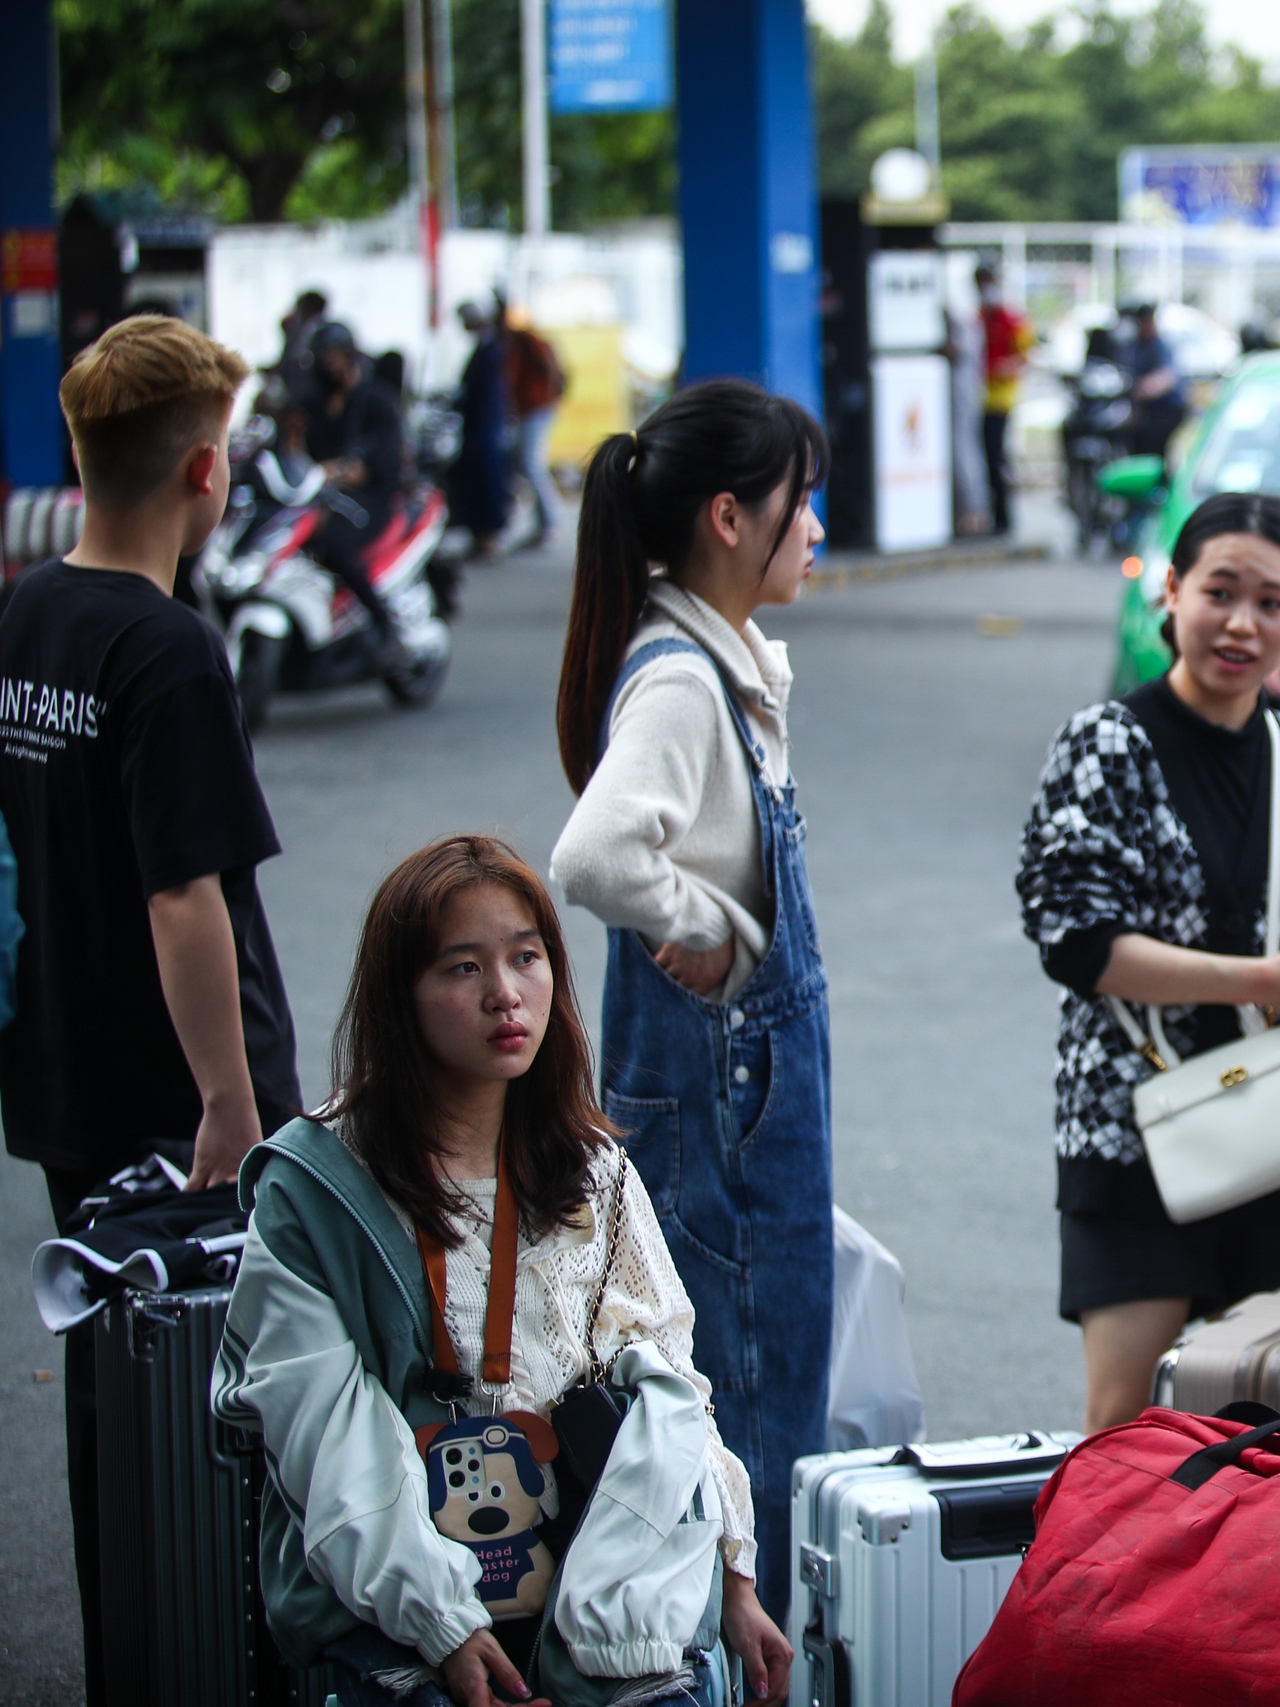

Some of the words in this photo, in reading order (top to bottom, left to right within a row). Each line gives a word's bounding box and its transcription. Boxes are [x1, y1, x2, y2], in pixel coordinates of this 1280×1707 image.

[475, 1545, 512, 1560] Head
[482, 1558, 520, 1571] aster
[482, 1572, 510, 1583] dog
